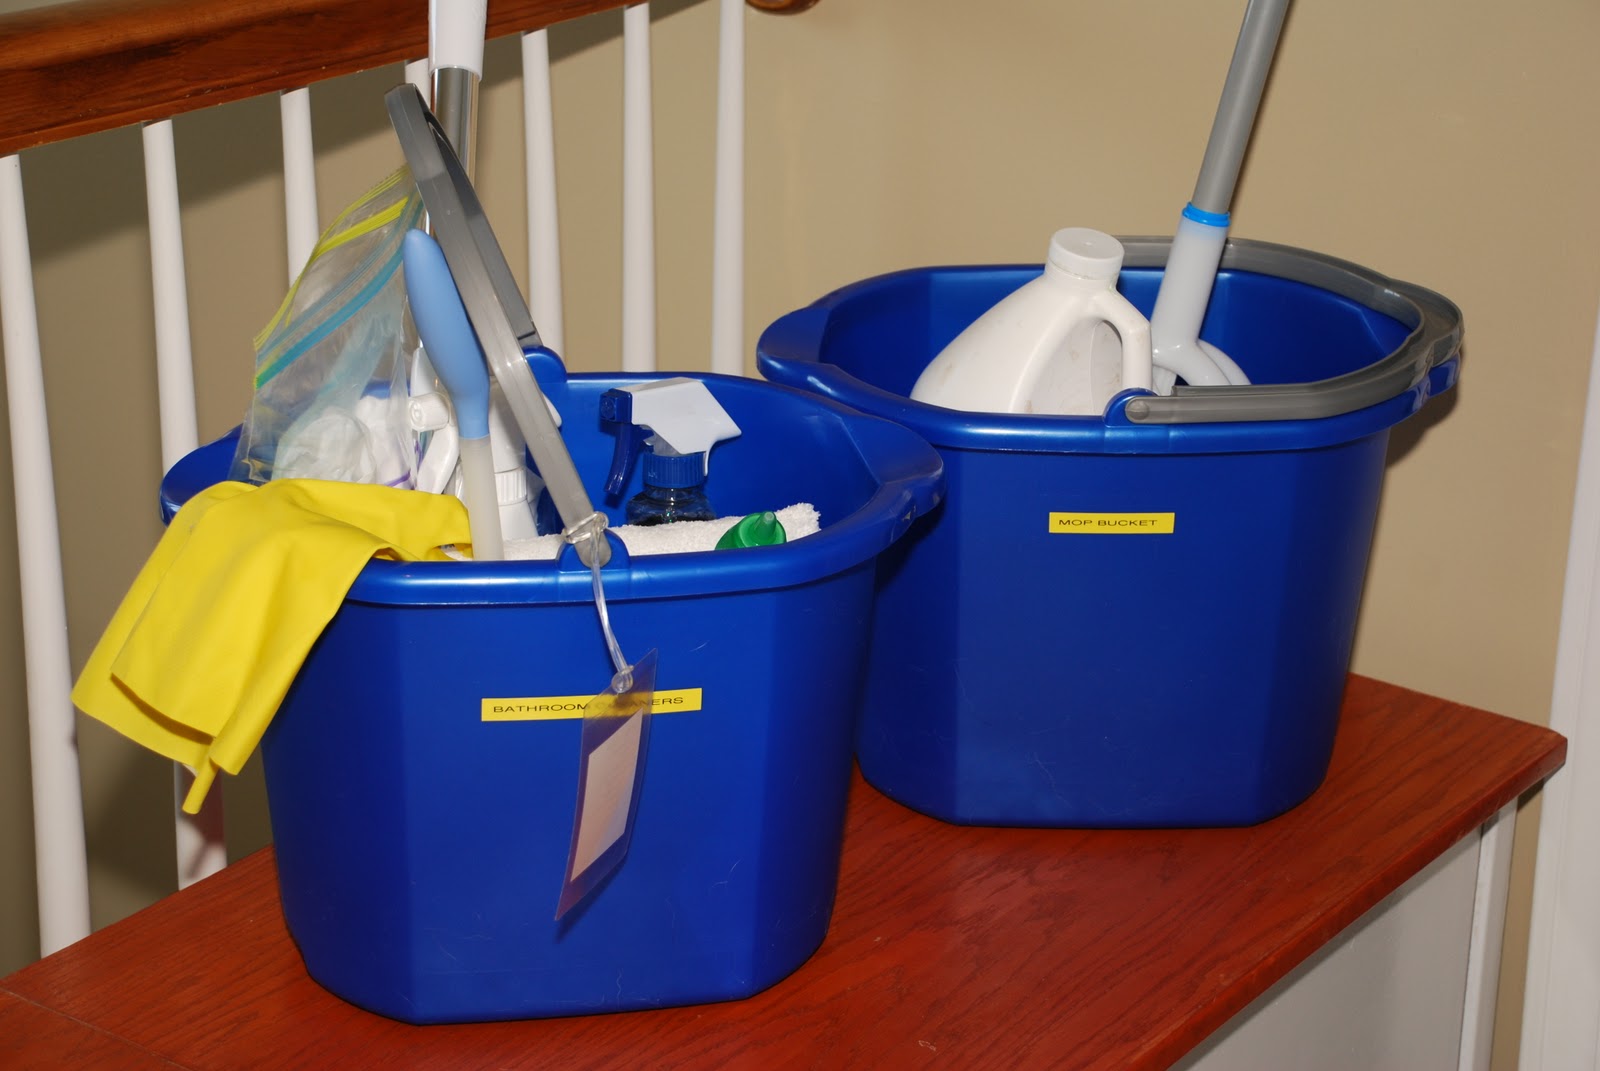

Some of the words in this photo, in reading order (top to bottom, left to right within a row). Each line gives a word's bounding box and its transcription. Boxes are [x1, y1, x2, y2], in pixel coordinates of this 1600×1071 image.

[1058, 519, 1092, 527] MOP
[1097, 519, 1158, 527] BUCKET
[493, 702, 588, 713] BATHROOM
